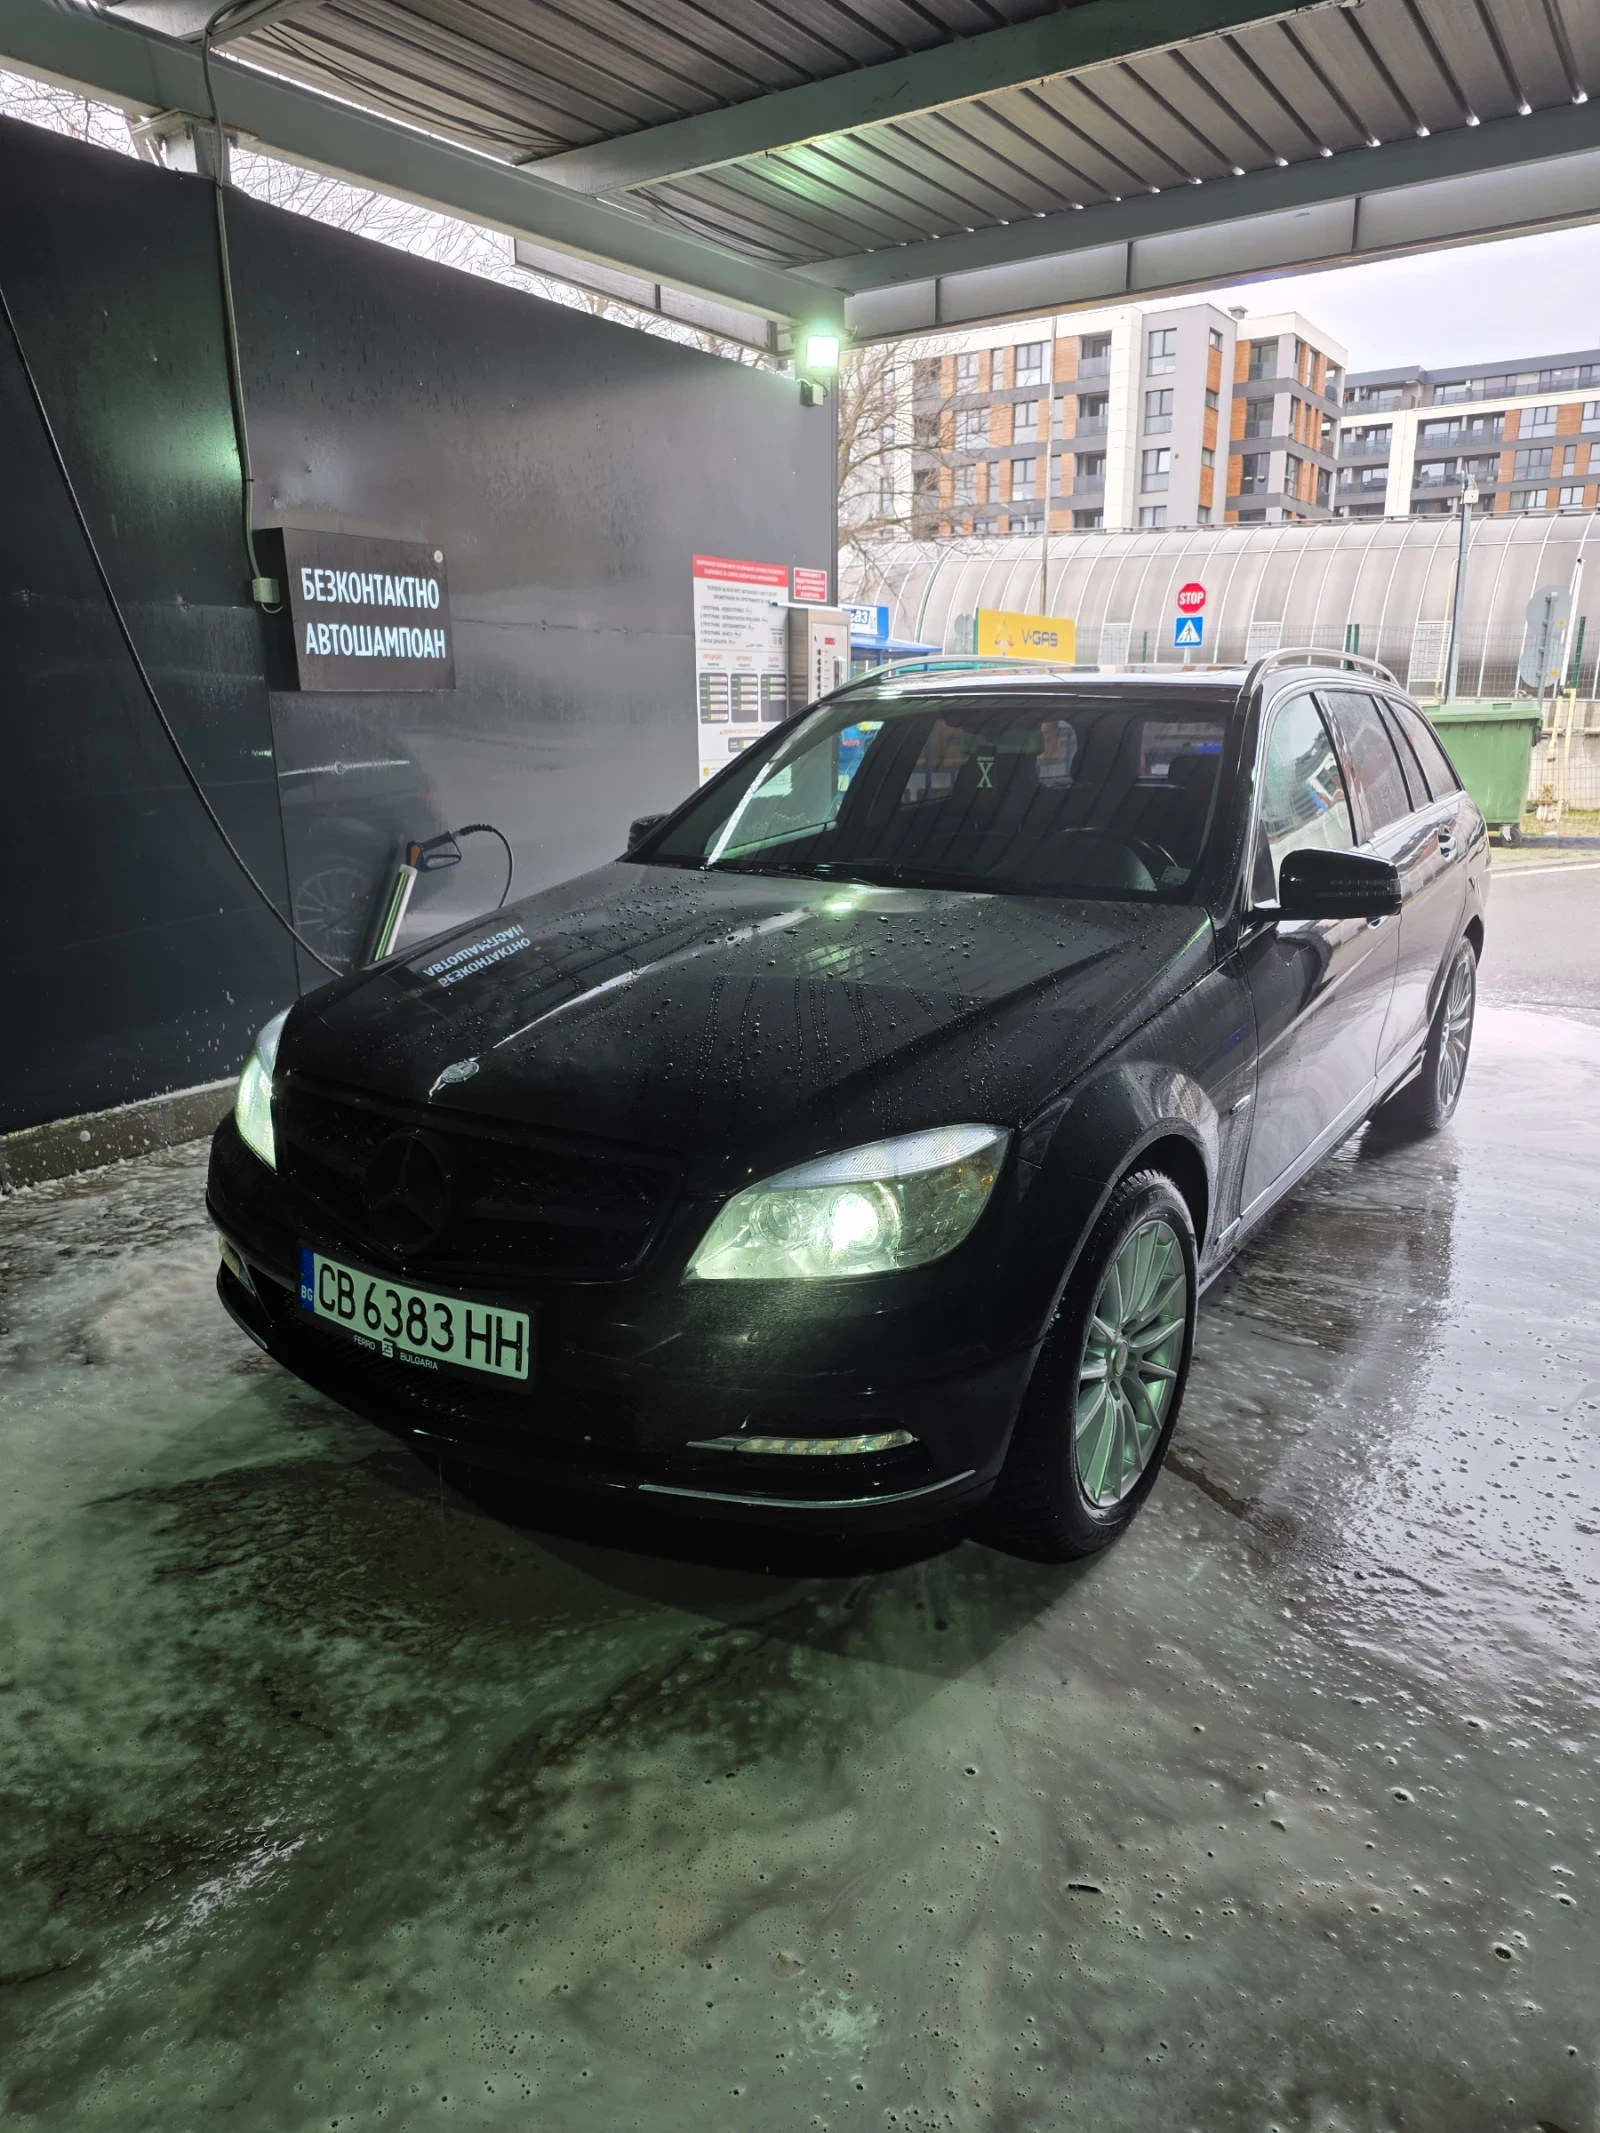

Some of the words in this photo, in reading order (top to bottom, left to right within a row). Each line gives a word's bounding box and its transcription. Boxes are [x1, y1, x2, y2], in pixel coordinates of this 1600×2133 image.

[301, 567, 440, 609] БЕЗКОНТАКТНО
[1179, 592, 1205, 605] STOP
[305, 622, 446, 658] АВТОШАМПОАН
[976, 761, 994, 788] X
[300, 1284, 314, 1302] BG
[318, 1263, 356, 1321] CB
[363, 1282, 455, 1353] 6383
[465, 1309, 524, 1373] HH
[353, 1334, 376, 1351] FERRO
[400, 1352, 439, 1371] BULGARIA
